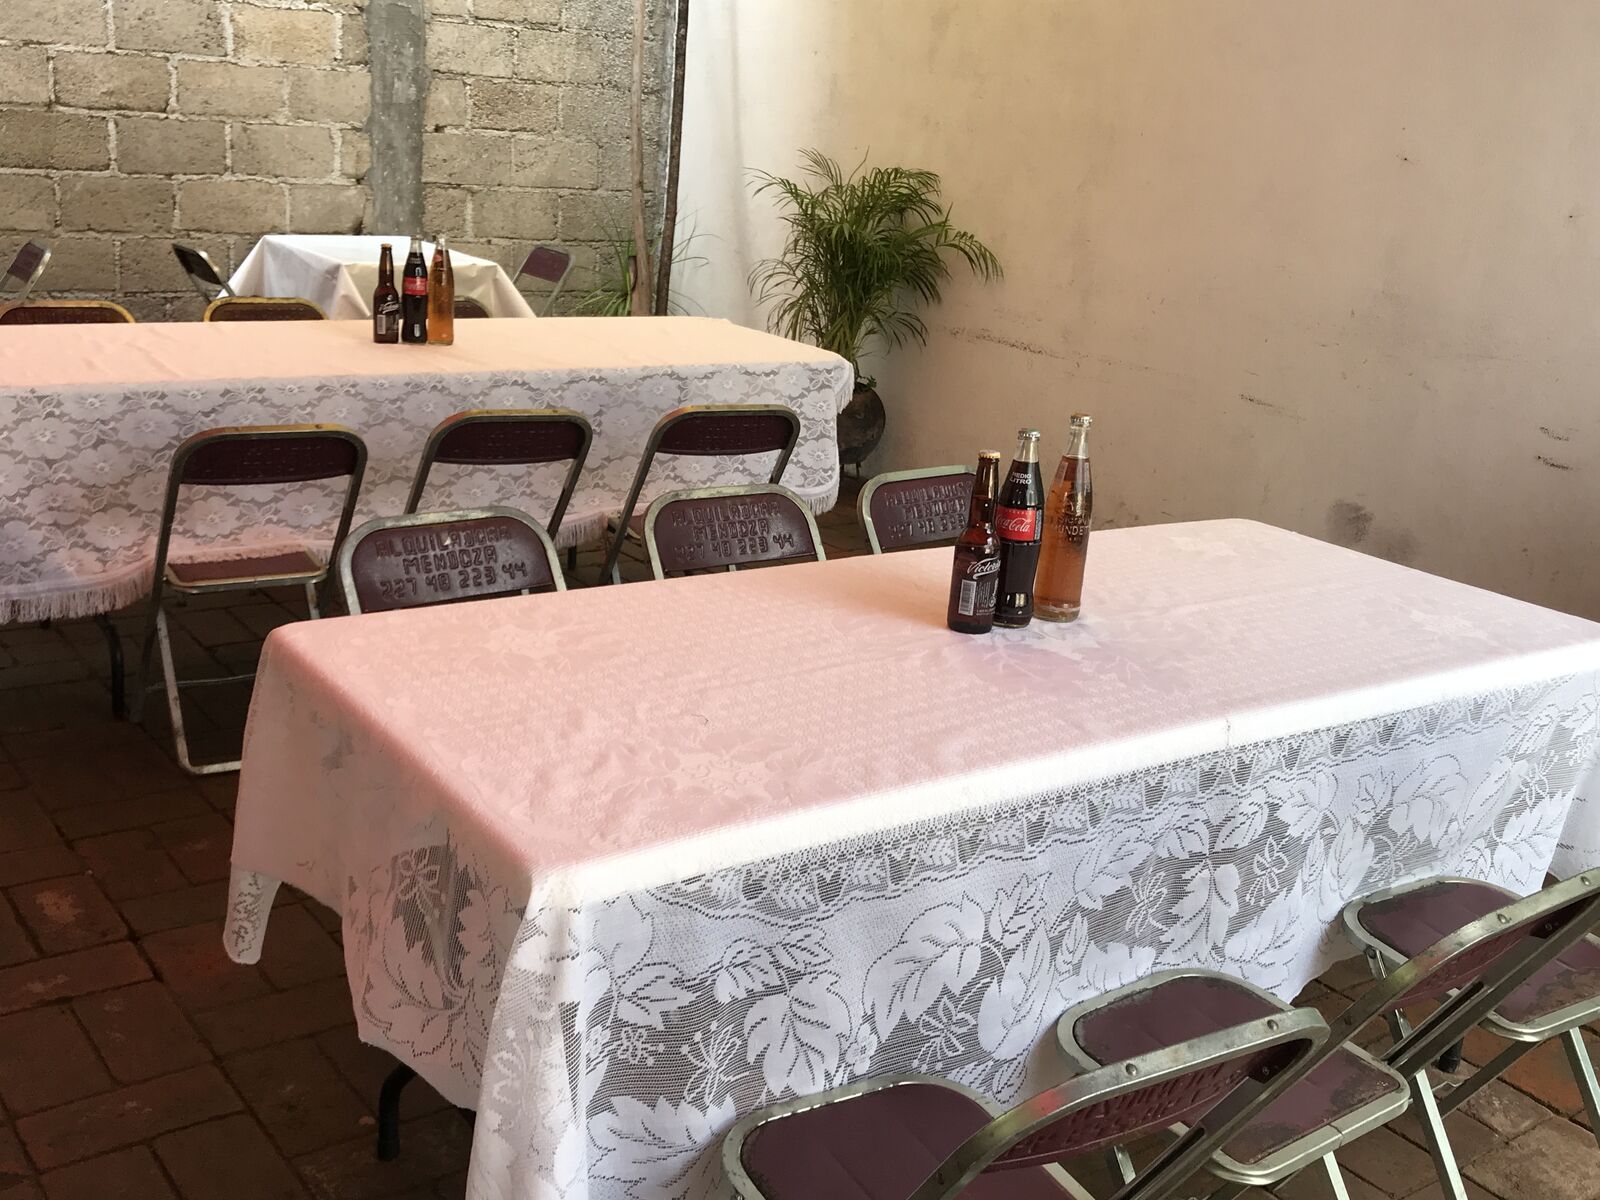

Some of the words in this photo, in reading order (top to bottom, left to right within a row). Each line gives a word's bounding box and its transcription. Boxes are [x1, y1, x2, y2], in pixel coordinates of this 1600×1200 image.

[1010, 477, 1032, 485] LITRO
[693, 518, 770, 541] MENDOZA
[402, 545, 498, 576] MENDOZA
[380, 577, 417, 600] 227
[458, 566, 497, 589] 223
[501, 559, 528, 580] 44
